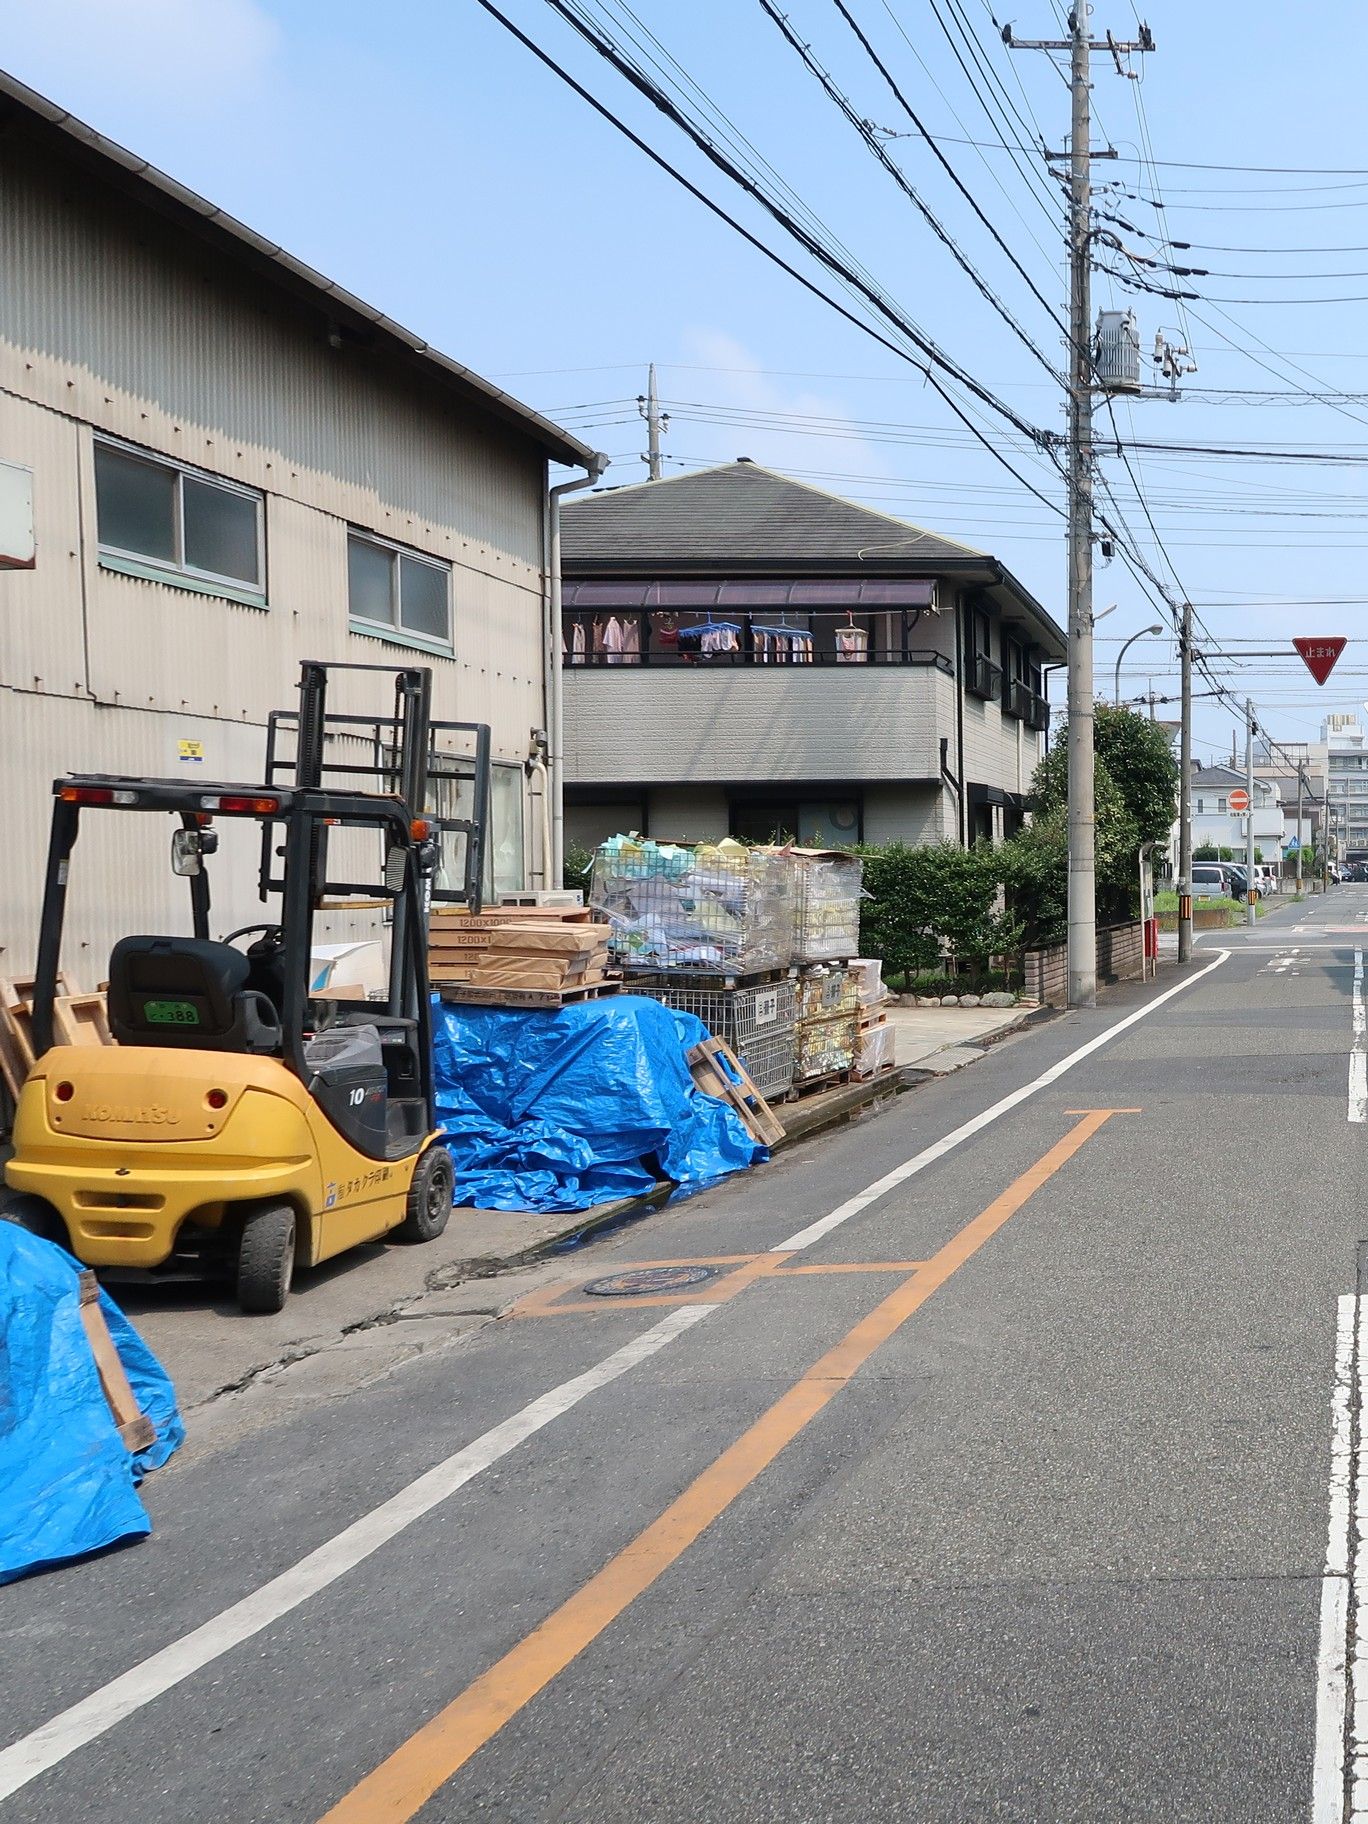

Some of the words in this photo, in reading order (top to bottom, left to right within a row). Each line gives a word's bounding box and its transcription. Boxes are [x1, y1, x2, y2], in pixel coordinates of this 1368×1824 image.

[1305, 646, 1336, 658] 止まれ
[349, 1087, 365, 1106] 10
